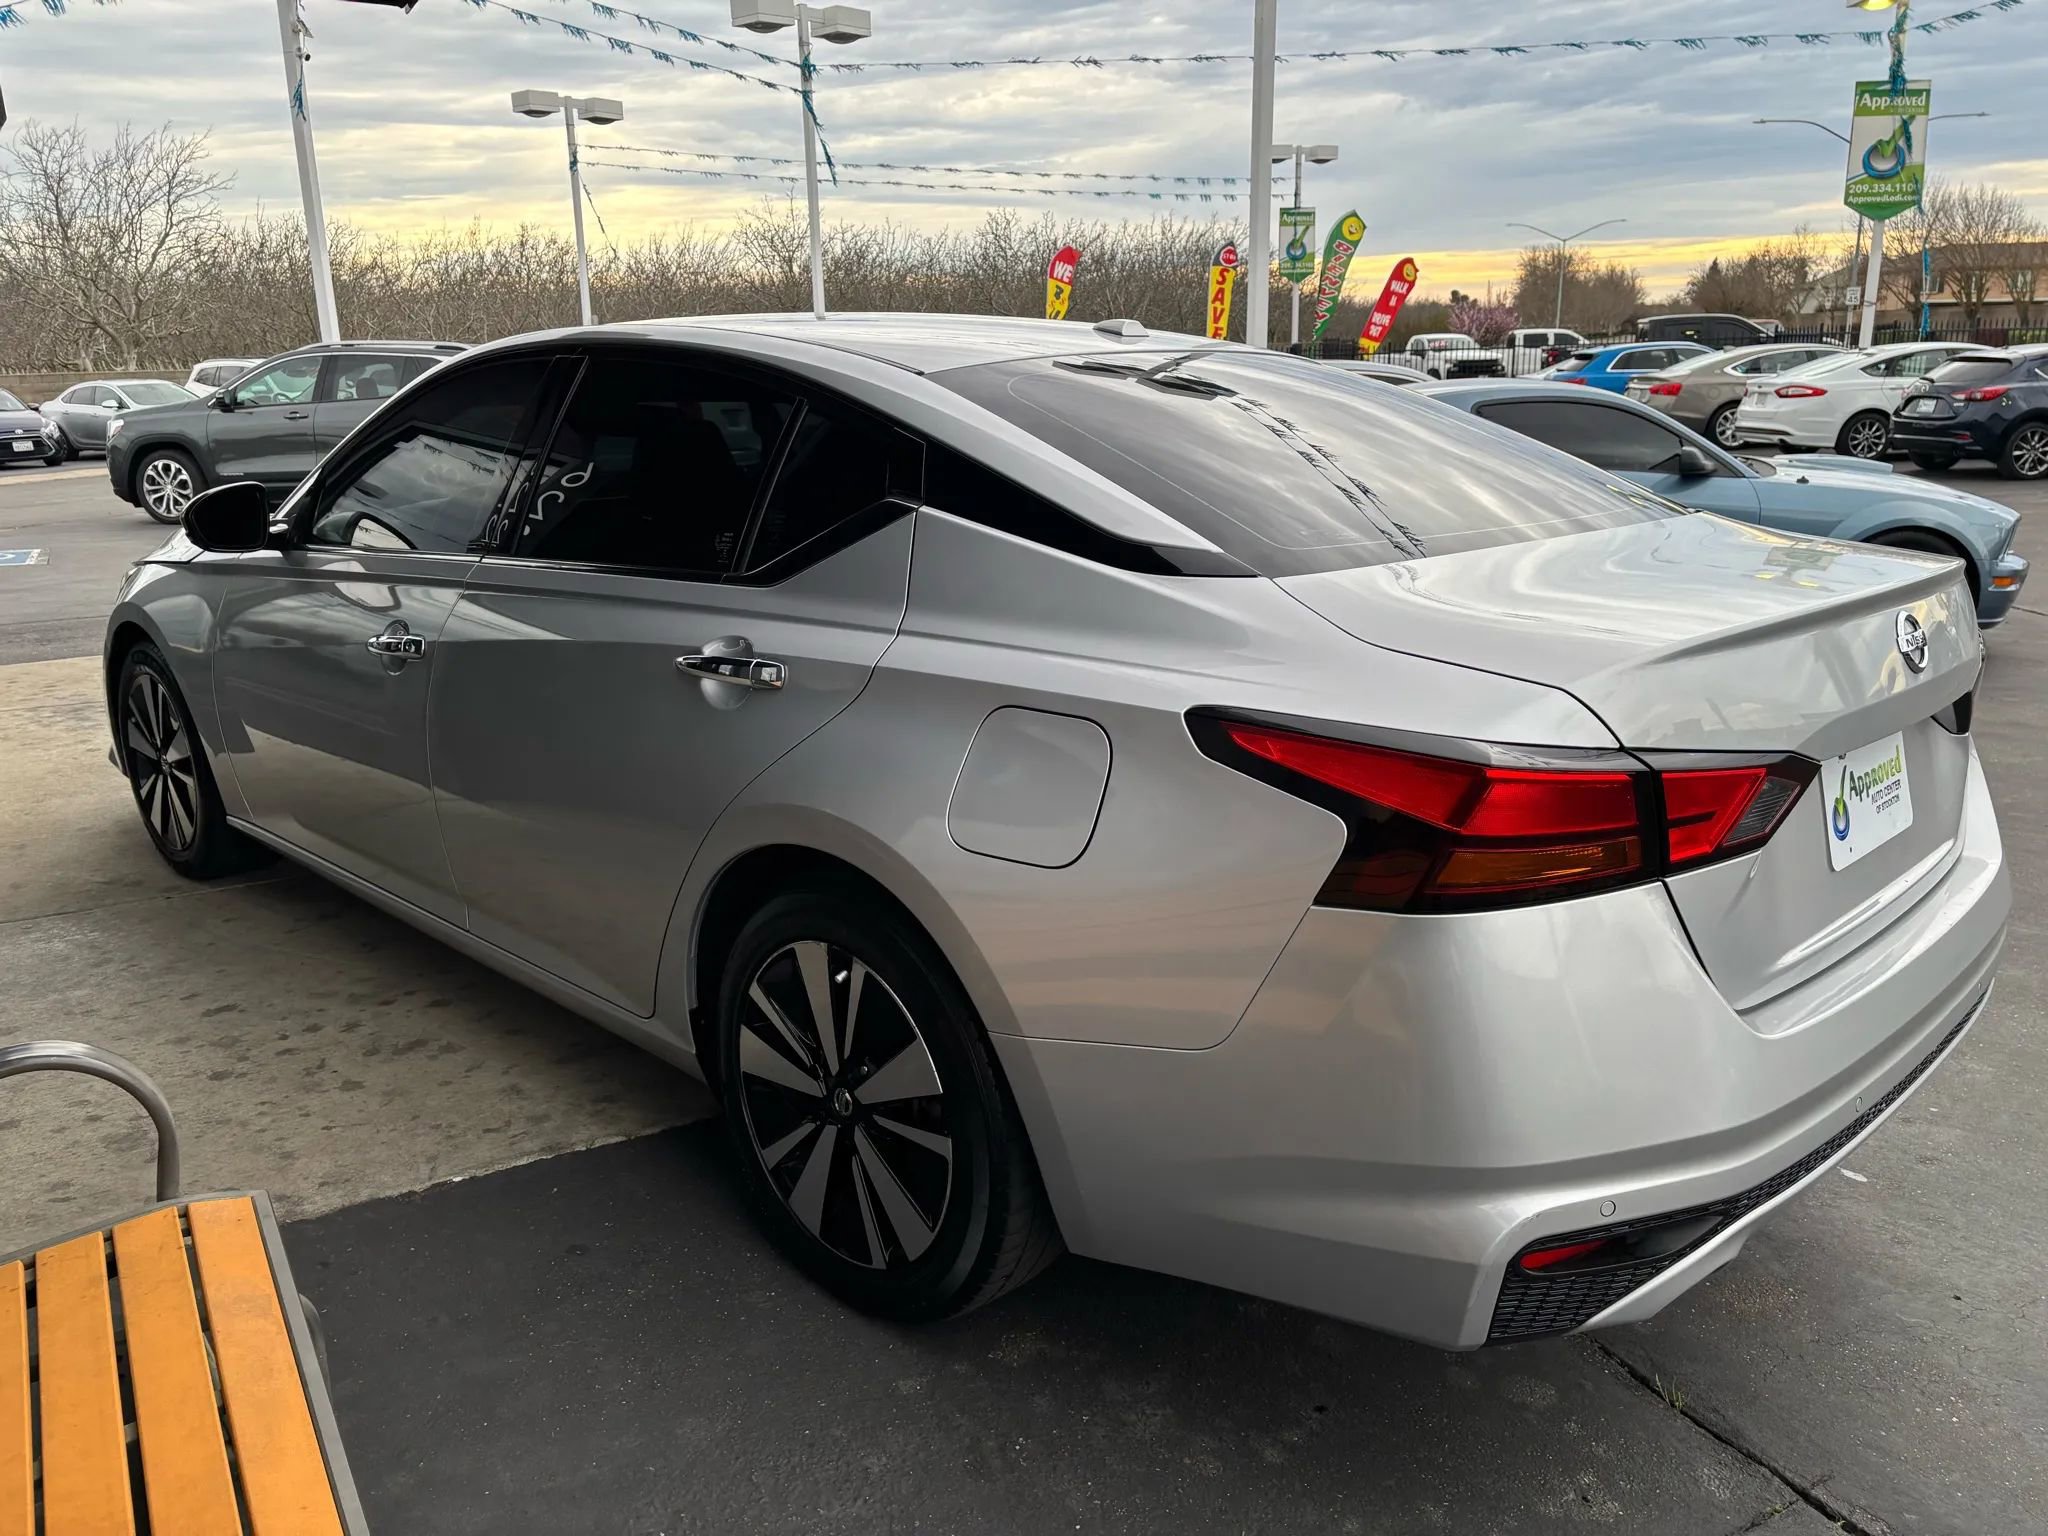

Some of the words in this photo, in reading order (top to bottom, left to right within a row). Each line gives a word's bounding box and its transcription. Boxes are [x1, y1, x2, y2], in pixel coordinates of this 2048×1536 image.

[1053, 260, 1073, 283] WE
[1211, 267, 1230, 339] SAVE
[1871, 788, 1884, 805] AUTO
[1883, 779, 1902, 797] CENTER
[1875, 804, 1882, 815] OF
[1881, 793, 1901, 811] STOCKTON
